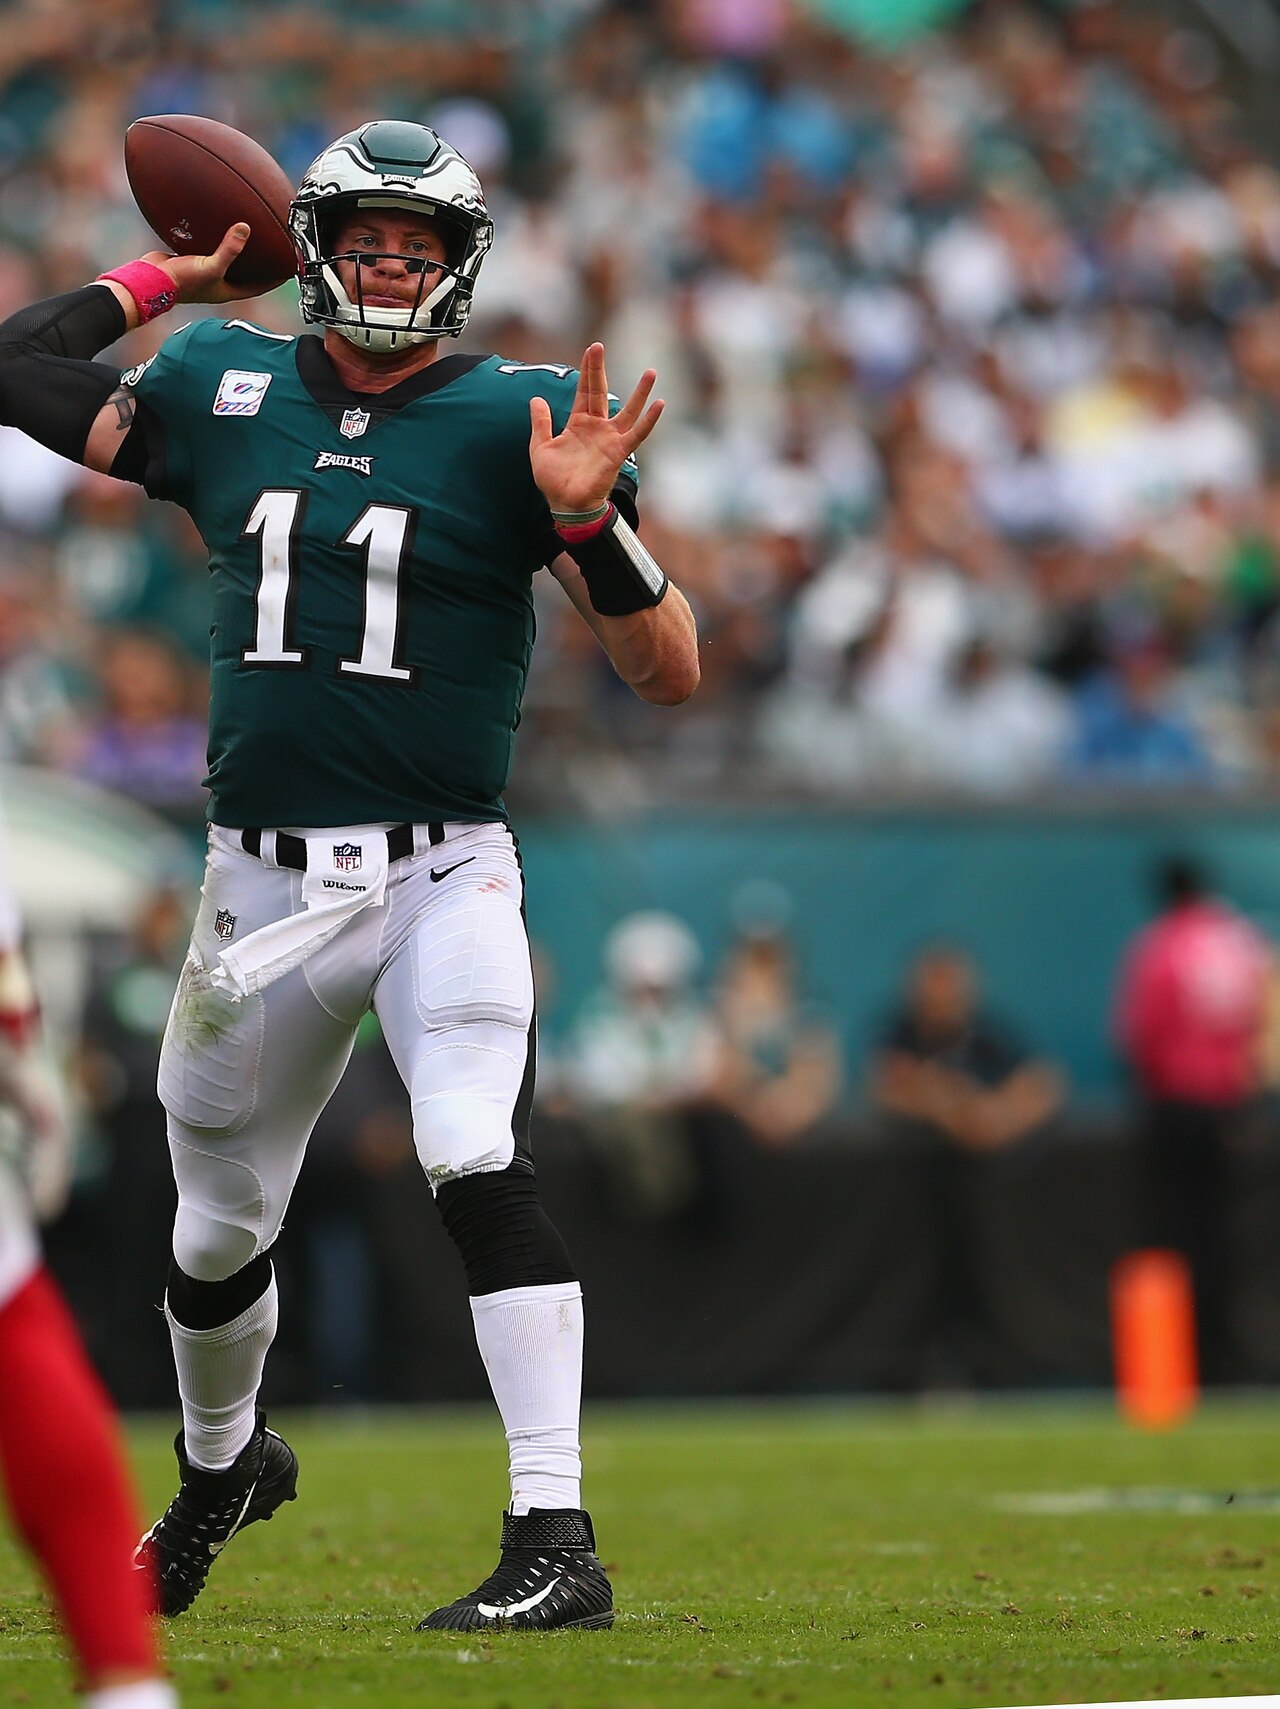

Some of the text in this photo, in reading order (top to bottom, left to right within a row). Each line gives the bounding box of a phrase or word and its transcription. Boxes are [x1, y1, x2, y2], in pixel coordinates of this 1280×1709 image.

[314, 451, 374, 476] EAGLES
[243, 490, 412, 681] 11
[336, 857, 360, 871] NFL
[322, 879, 367, 892] Wilson
